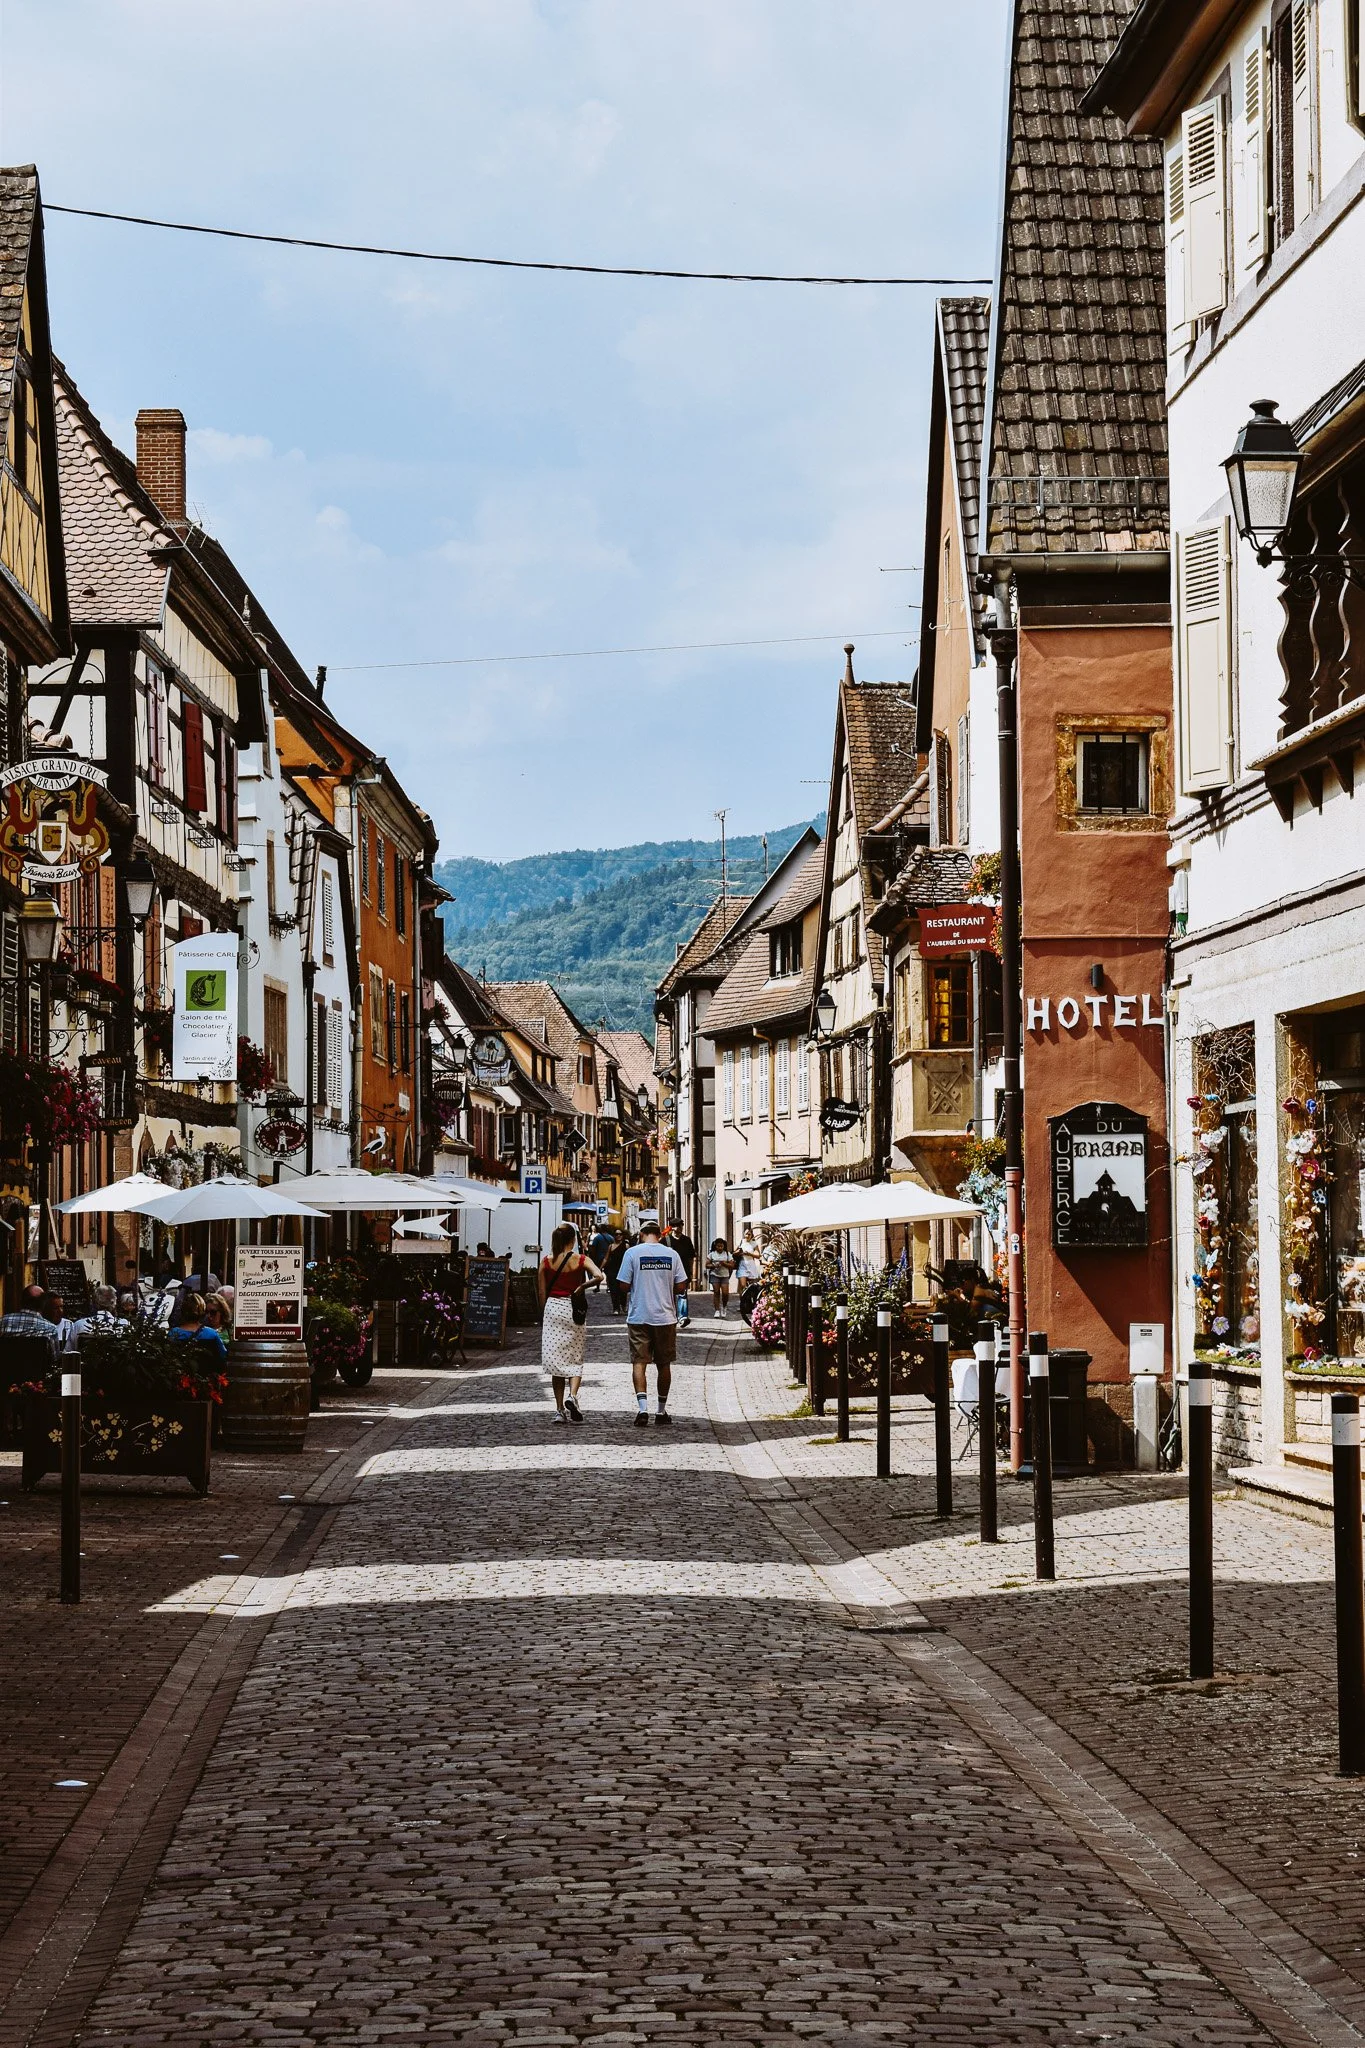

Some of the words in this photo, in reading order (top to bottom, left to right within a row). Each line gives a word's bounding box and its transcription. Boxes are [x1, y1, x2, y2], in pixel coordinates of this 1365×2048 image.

[4, 760, 39, 783] ALSACE
[41, 759, 77, 772] GRAND
[80, 764, 101, 780] CRU
[36, 776, 70, 788] BRAND
[926, 916, 986, 928] RESTAURANT
[926, 939, 957, 947] L'AUBERGE
[1027, 993, 1166, 1031] HOTEL
[1096, 1121, 1122, 1133] DU
[1073, 1141, 1144, 1157] BRAND
